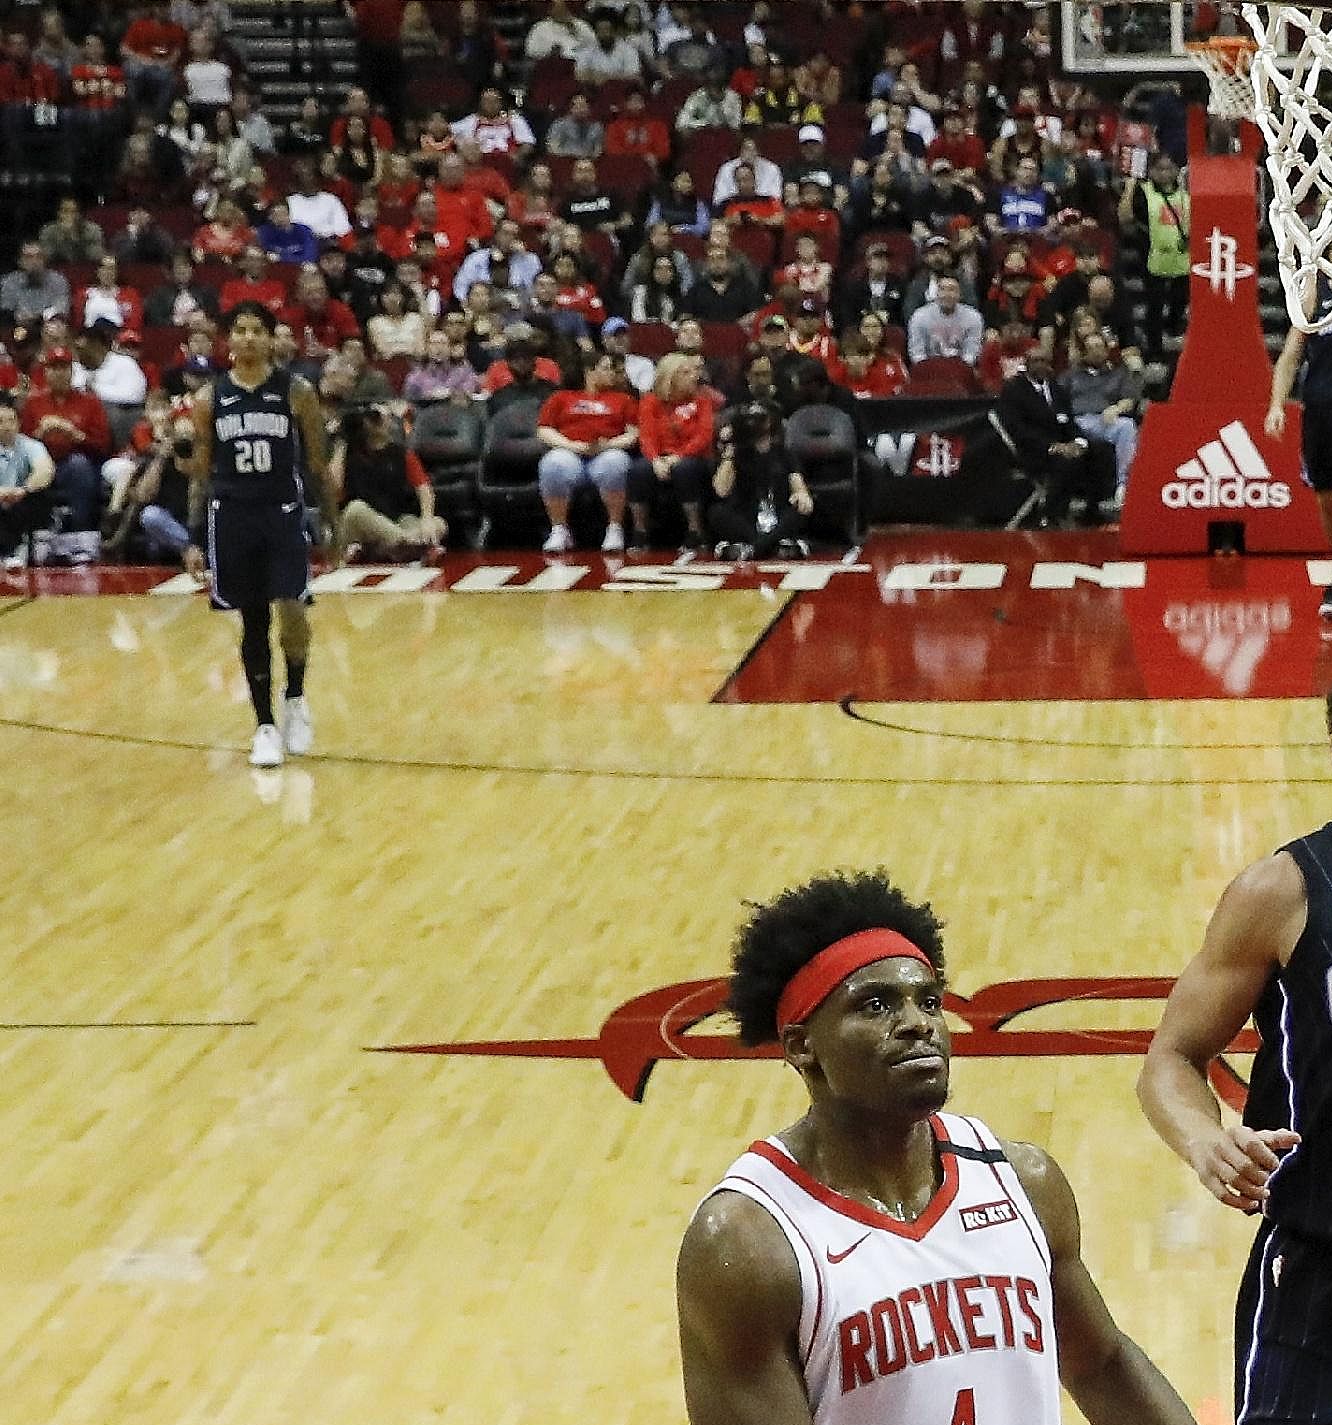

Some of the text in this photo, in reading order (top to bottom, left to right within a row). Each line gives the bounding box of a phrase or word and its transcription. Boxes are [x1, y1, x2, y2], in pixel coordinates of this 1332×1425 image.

[234, 440, 272, 473] 20
[1161, 474, 1292, 508] adidas
[838, 1274, 1044, 1395] ROCKETS
